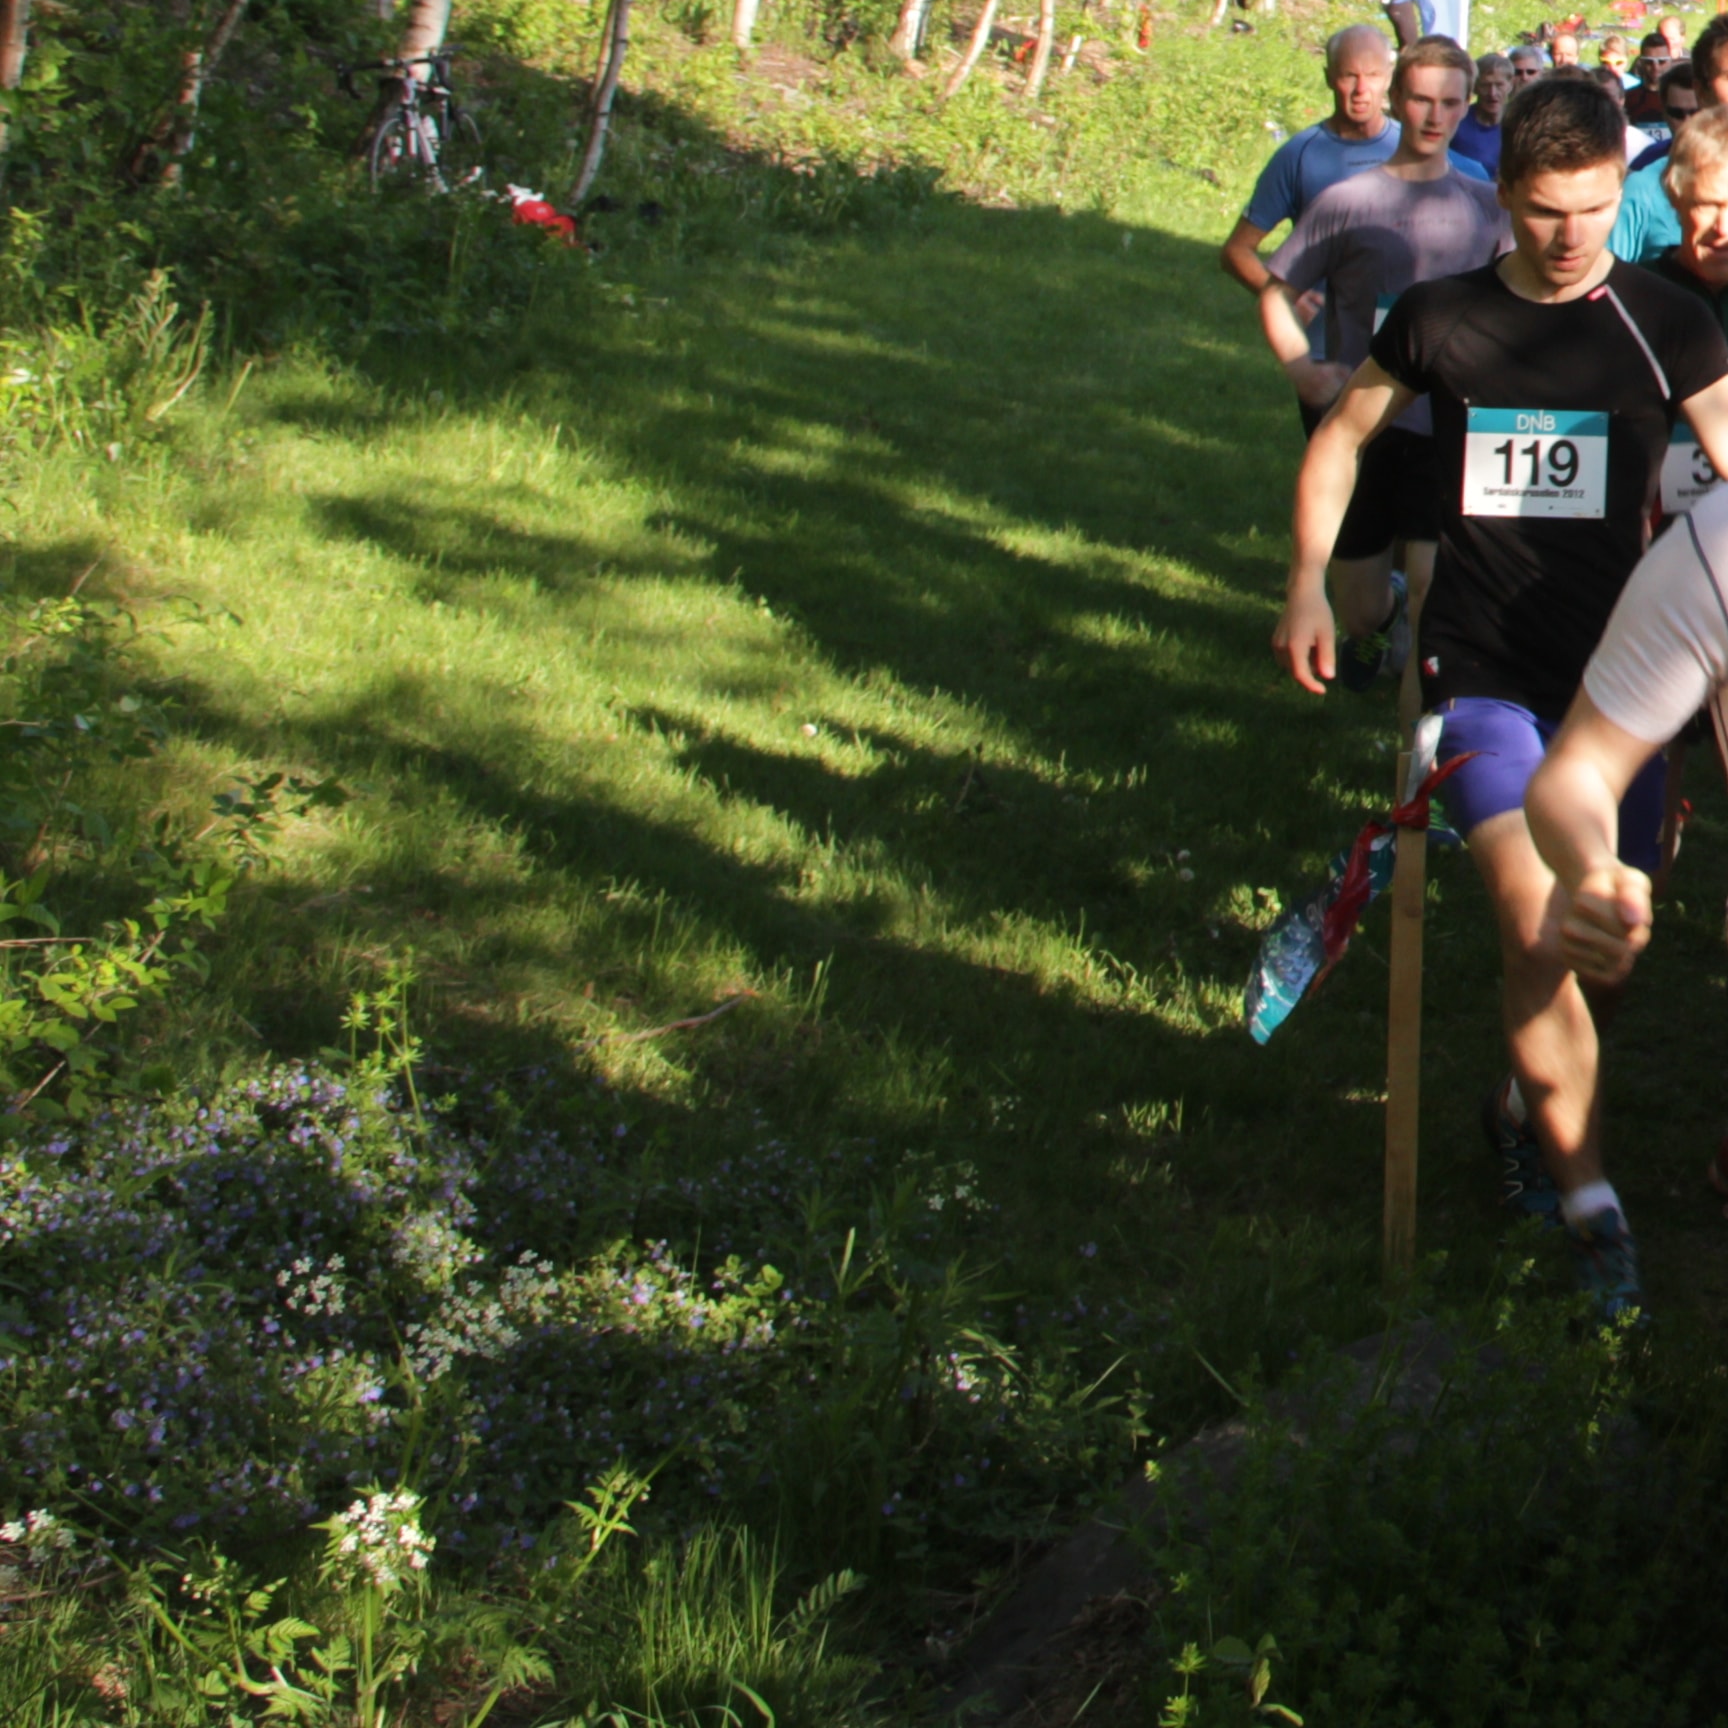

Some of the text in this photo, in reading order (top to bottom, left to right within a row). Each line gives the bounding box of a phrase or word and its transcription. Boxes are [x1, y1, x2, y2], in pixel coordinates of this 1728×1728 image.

[1516, 409, 1556, 434] DNB
[1494, 438, 1579, 487] 119
[1692, 448, 1719, 485] 3
[1562, 489, 1585, 498] 2012
